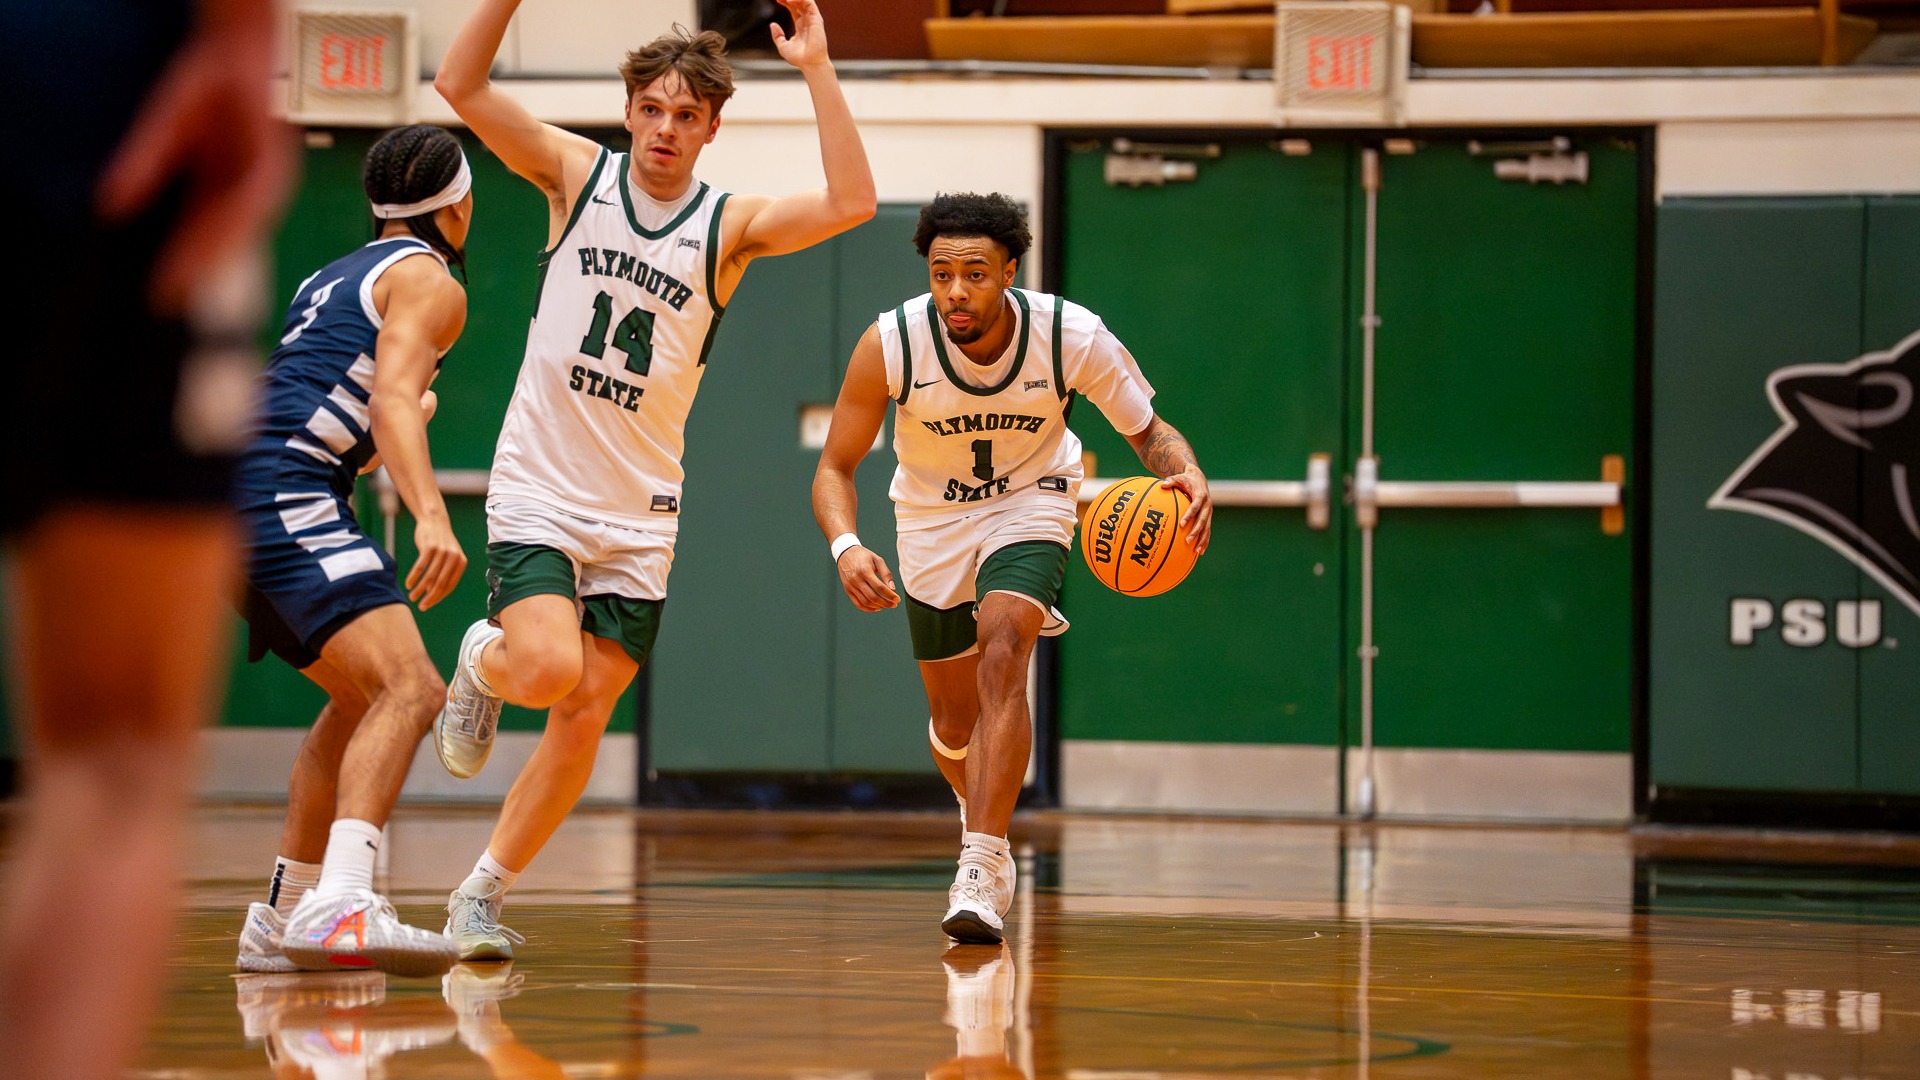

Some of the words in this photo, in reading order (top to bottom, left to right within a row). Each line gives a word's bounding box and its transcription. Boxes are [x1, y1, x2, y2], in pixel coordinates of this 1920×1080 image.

[320, 33, 386, 89] EXIT
[1307, 34, 1374, 88] EXIT
[577, 246, 694, 313] PLYMOUTH
[579, 289, 656, 378] 14
[569, 364, 645, 413] STATE
[920, 412, 1047, 437] PLYMOUTH
[970, 438, 995, 482] 1
[943, 475, 1012, 503] STATE
[1095, 489, 1136, 564] Wilson
[1130, 508, 1165, 567] NCAA
[1730, 598, 1882, 648] PSU
